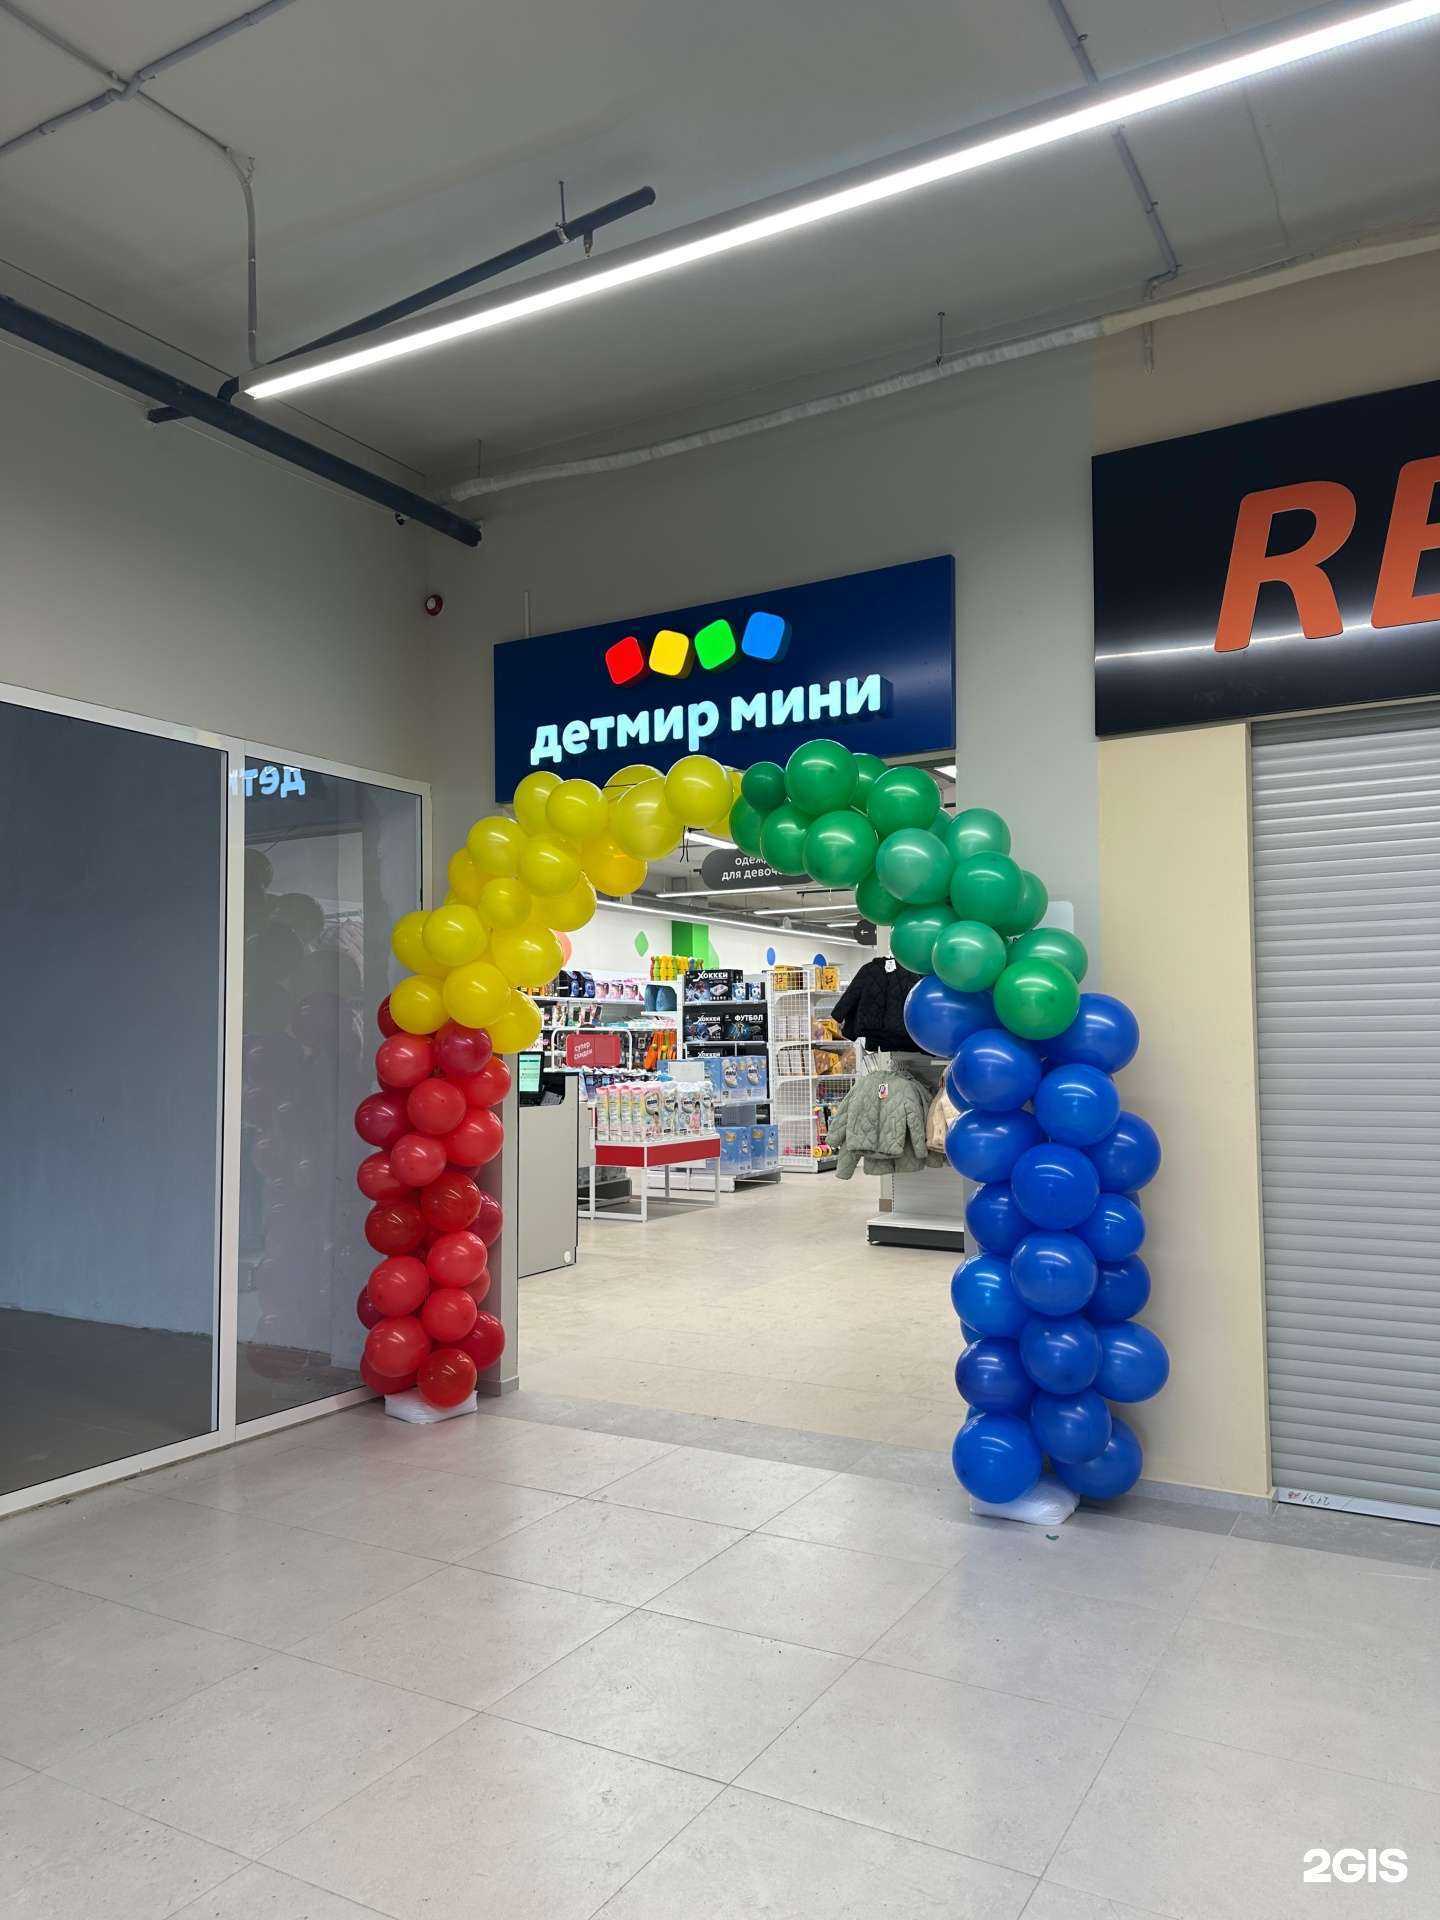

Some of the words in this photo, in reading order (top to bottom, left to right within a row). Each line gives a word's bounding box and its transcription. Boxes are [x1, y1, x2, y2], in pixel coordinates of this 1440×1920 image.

[530, 700, 720, 766] детмир
[730, 673, 882, 732] мини
[721, 870, 742, 882] для
[734, 1014, 764, 1022] ФУТБОЛ
